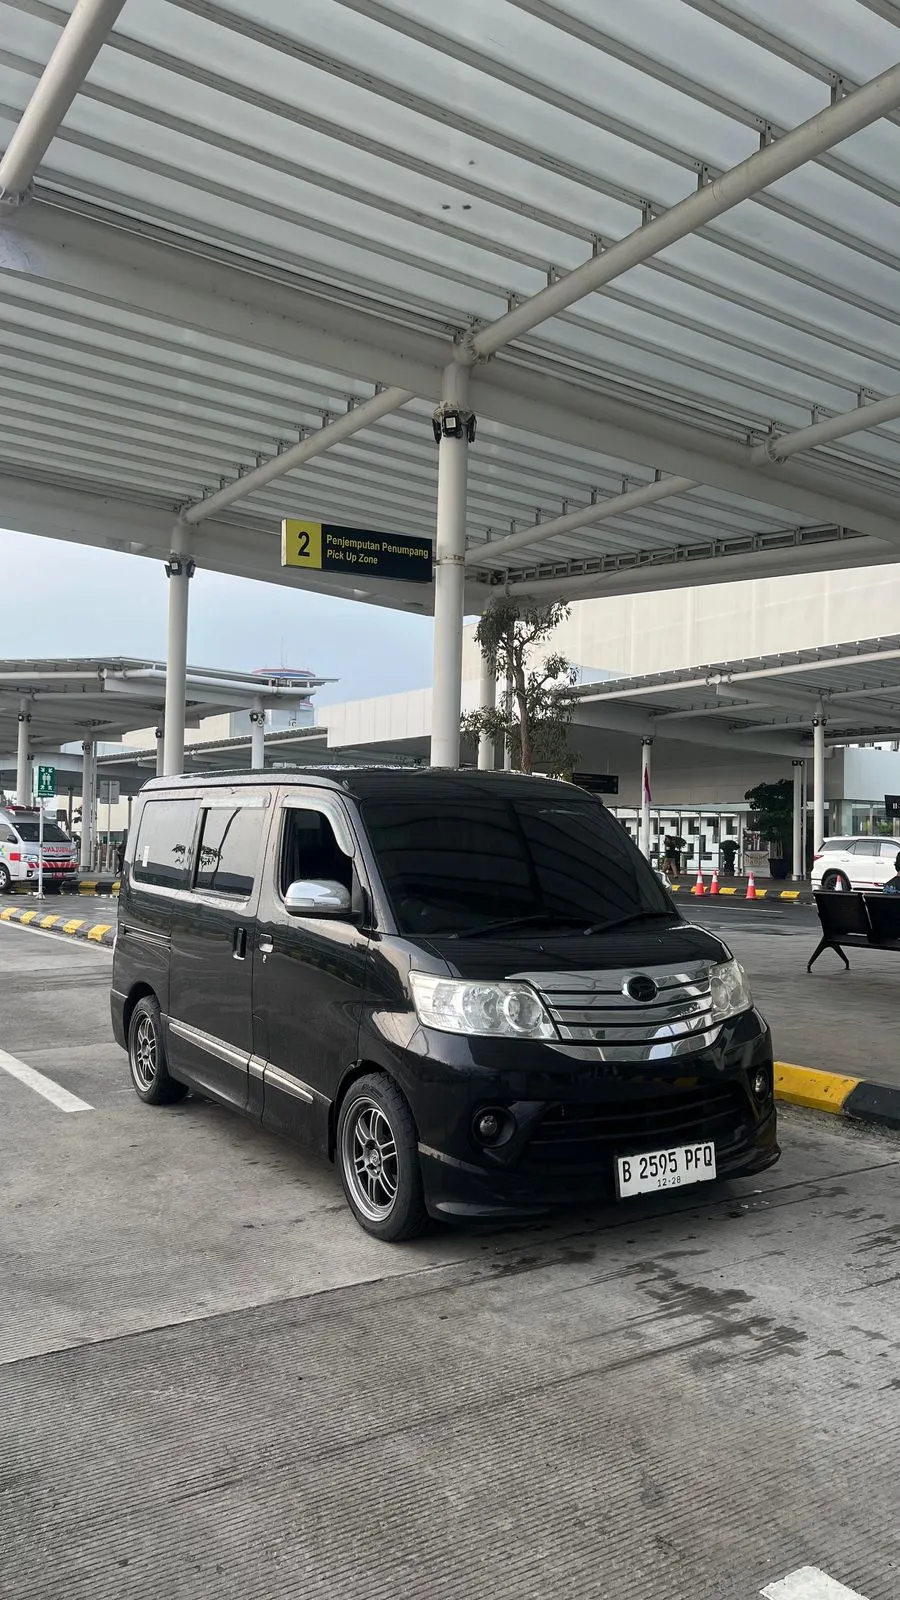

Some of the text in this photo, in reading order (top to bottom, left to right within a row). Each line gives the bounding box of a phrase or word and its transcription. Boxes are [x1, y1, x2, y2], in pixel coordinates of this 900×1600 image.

[297, 531, 310, 557] 2
[326, 534, 429, 559] Penjemputan Penumpang
[326, 549, 378, 565] Pick Up Zone
[622, 1145, 713, 1183] B 2595 PFQ
